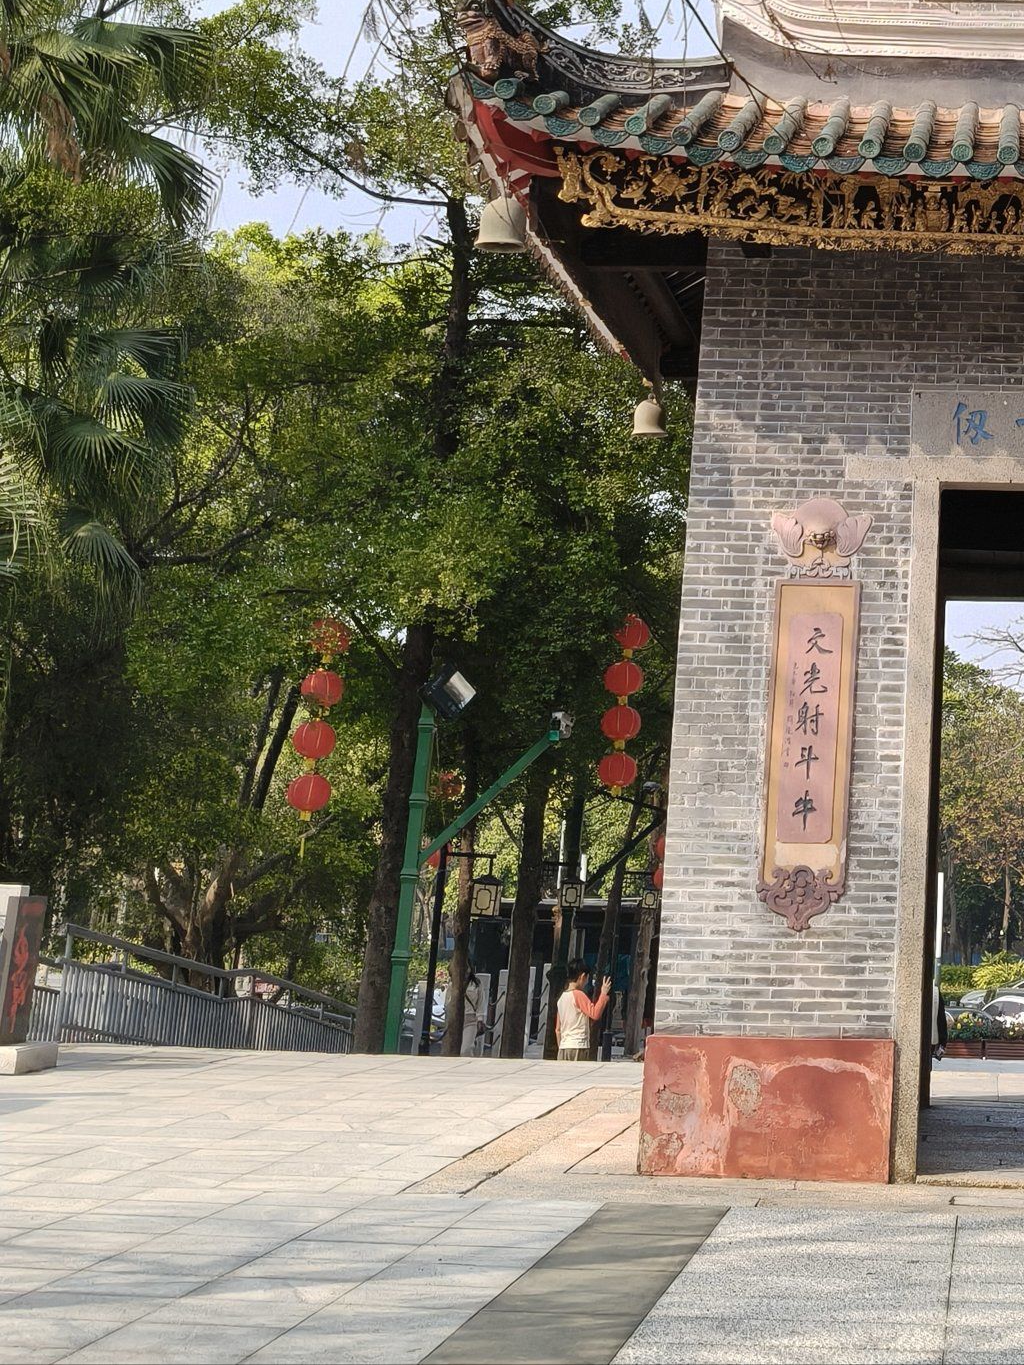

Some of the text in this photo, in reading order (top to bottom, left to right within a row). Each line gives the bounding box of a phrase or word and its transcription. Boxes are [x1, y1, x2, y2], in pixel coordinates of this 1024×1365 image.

[791, 627, 834, 832] 文光射斗牛
